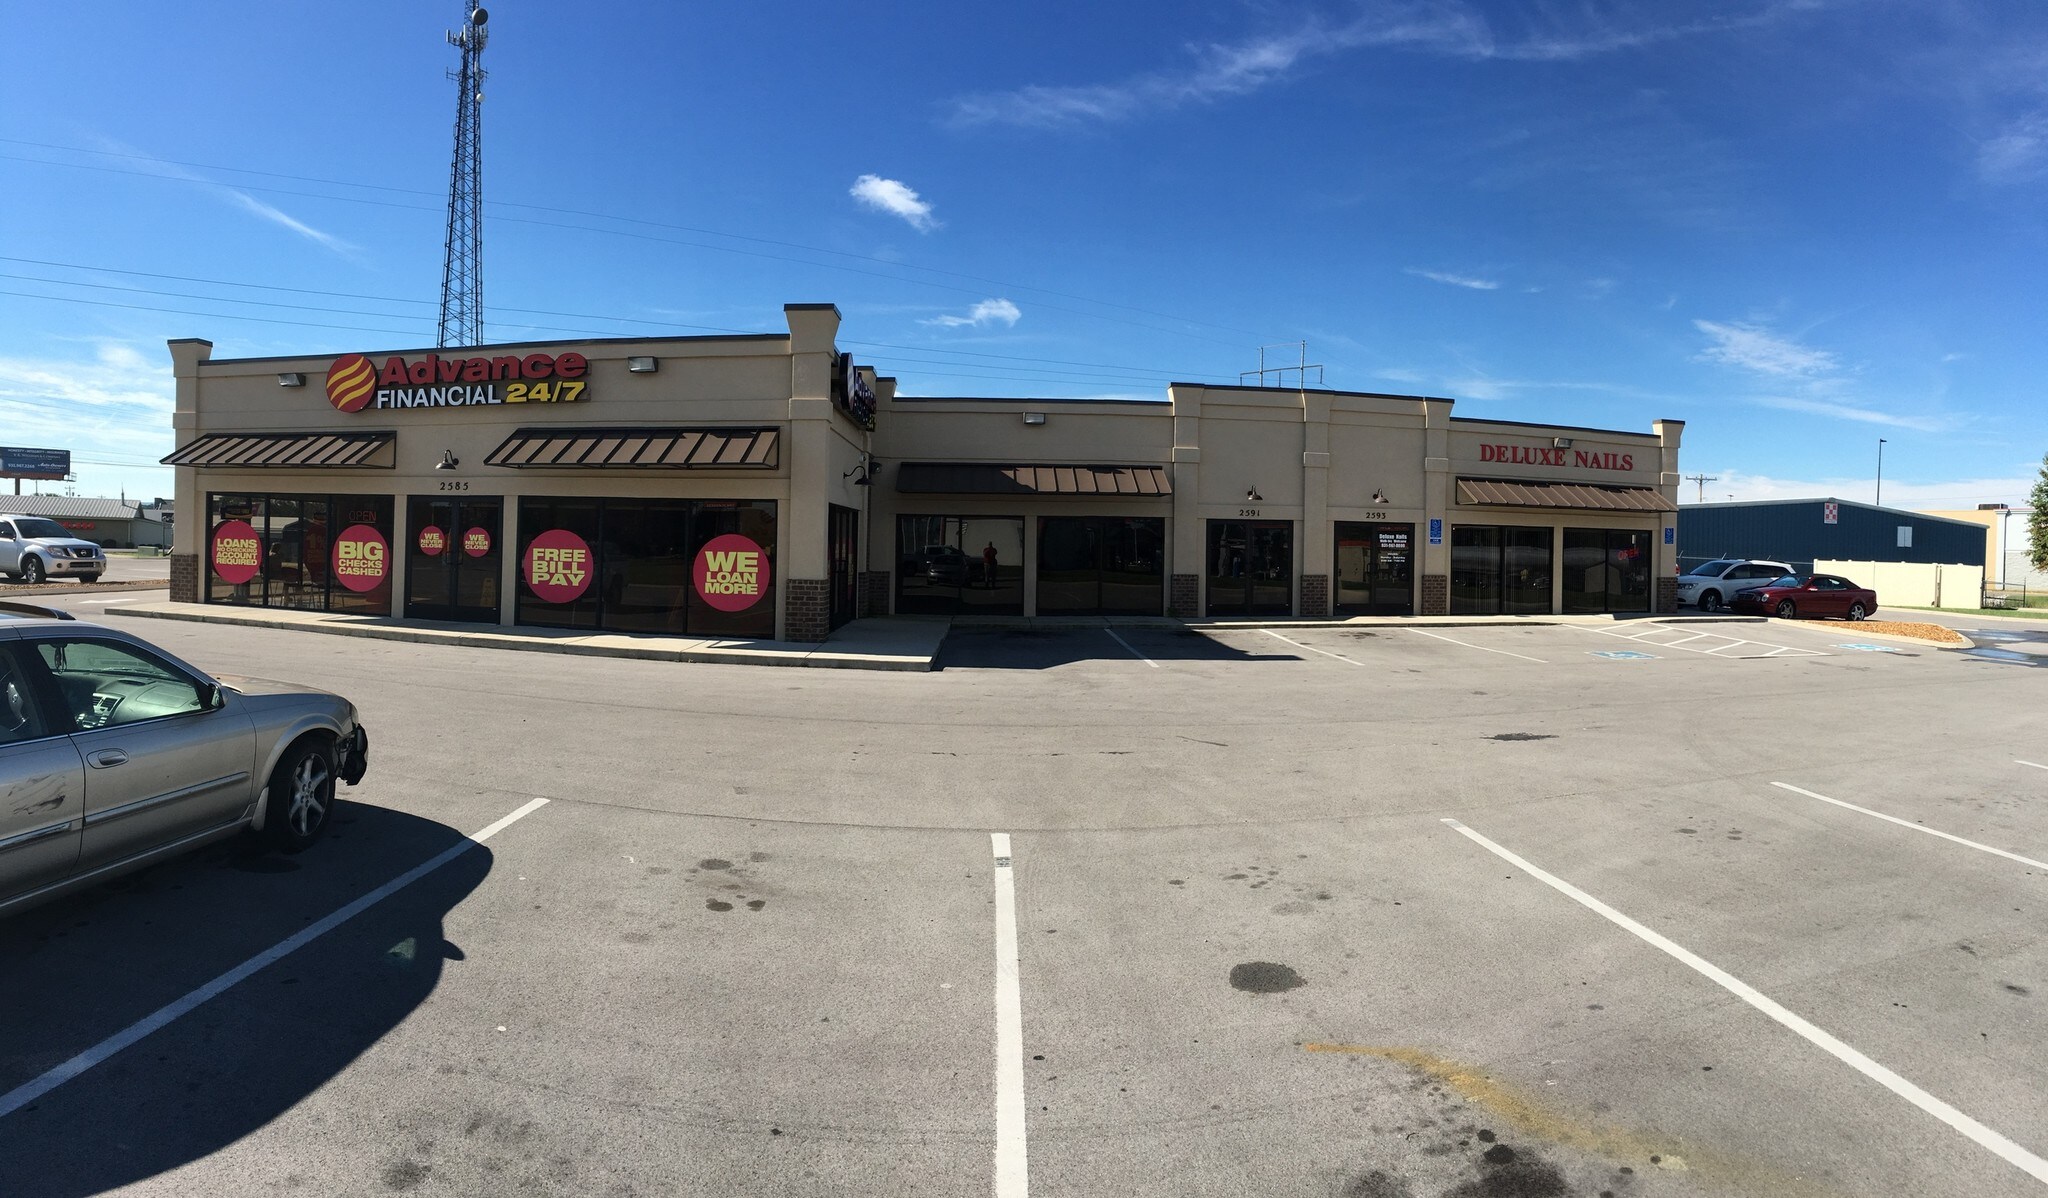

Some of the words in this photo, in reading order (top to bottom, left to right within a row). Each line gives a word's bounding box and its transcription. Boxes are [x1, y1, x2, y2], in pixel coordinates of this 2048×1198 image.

[378, 352, 588, 386] Advance
[377, 383, 502, 409] FINANCIAL
[505, 381, 585, 403] 24/7
[1479, 444, 1566, 467] DELUXE
[1574, 450, 1633, 471] NAILS
[439, 482, 469, 491] 2585
[349, 511, 377, 521] OPEN
[1239, 509, 1260, 517] 2591
[1365, 512, 1386, 520] 2593
[216, 538, 258, 549] LOANS
[216, 551, 258, 560] ACCOUNT
[338, 540, 383, 561] BIG
[532, 548, 586, 562] FREE
[216, 557, 258, 566] REQUIRED
[338, 559, 383, 569] CHECKS
[705, 551, 759, 573] WE
[338, 567, 383, 577] CASHED
[532, 561, 585, 575] BILL
[532, 573, 585, 586] PAY
[706, 572, 757, 584] LOAN
[704, 583, 758, 595] MORE
